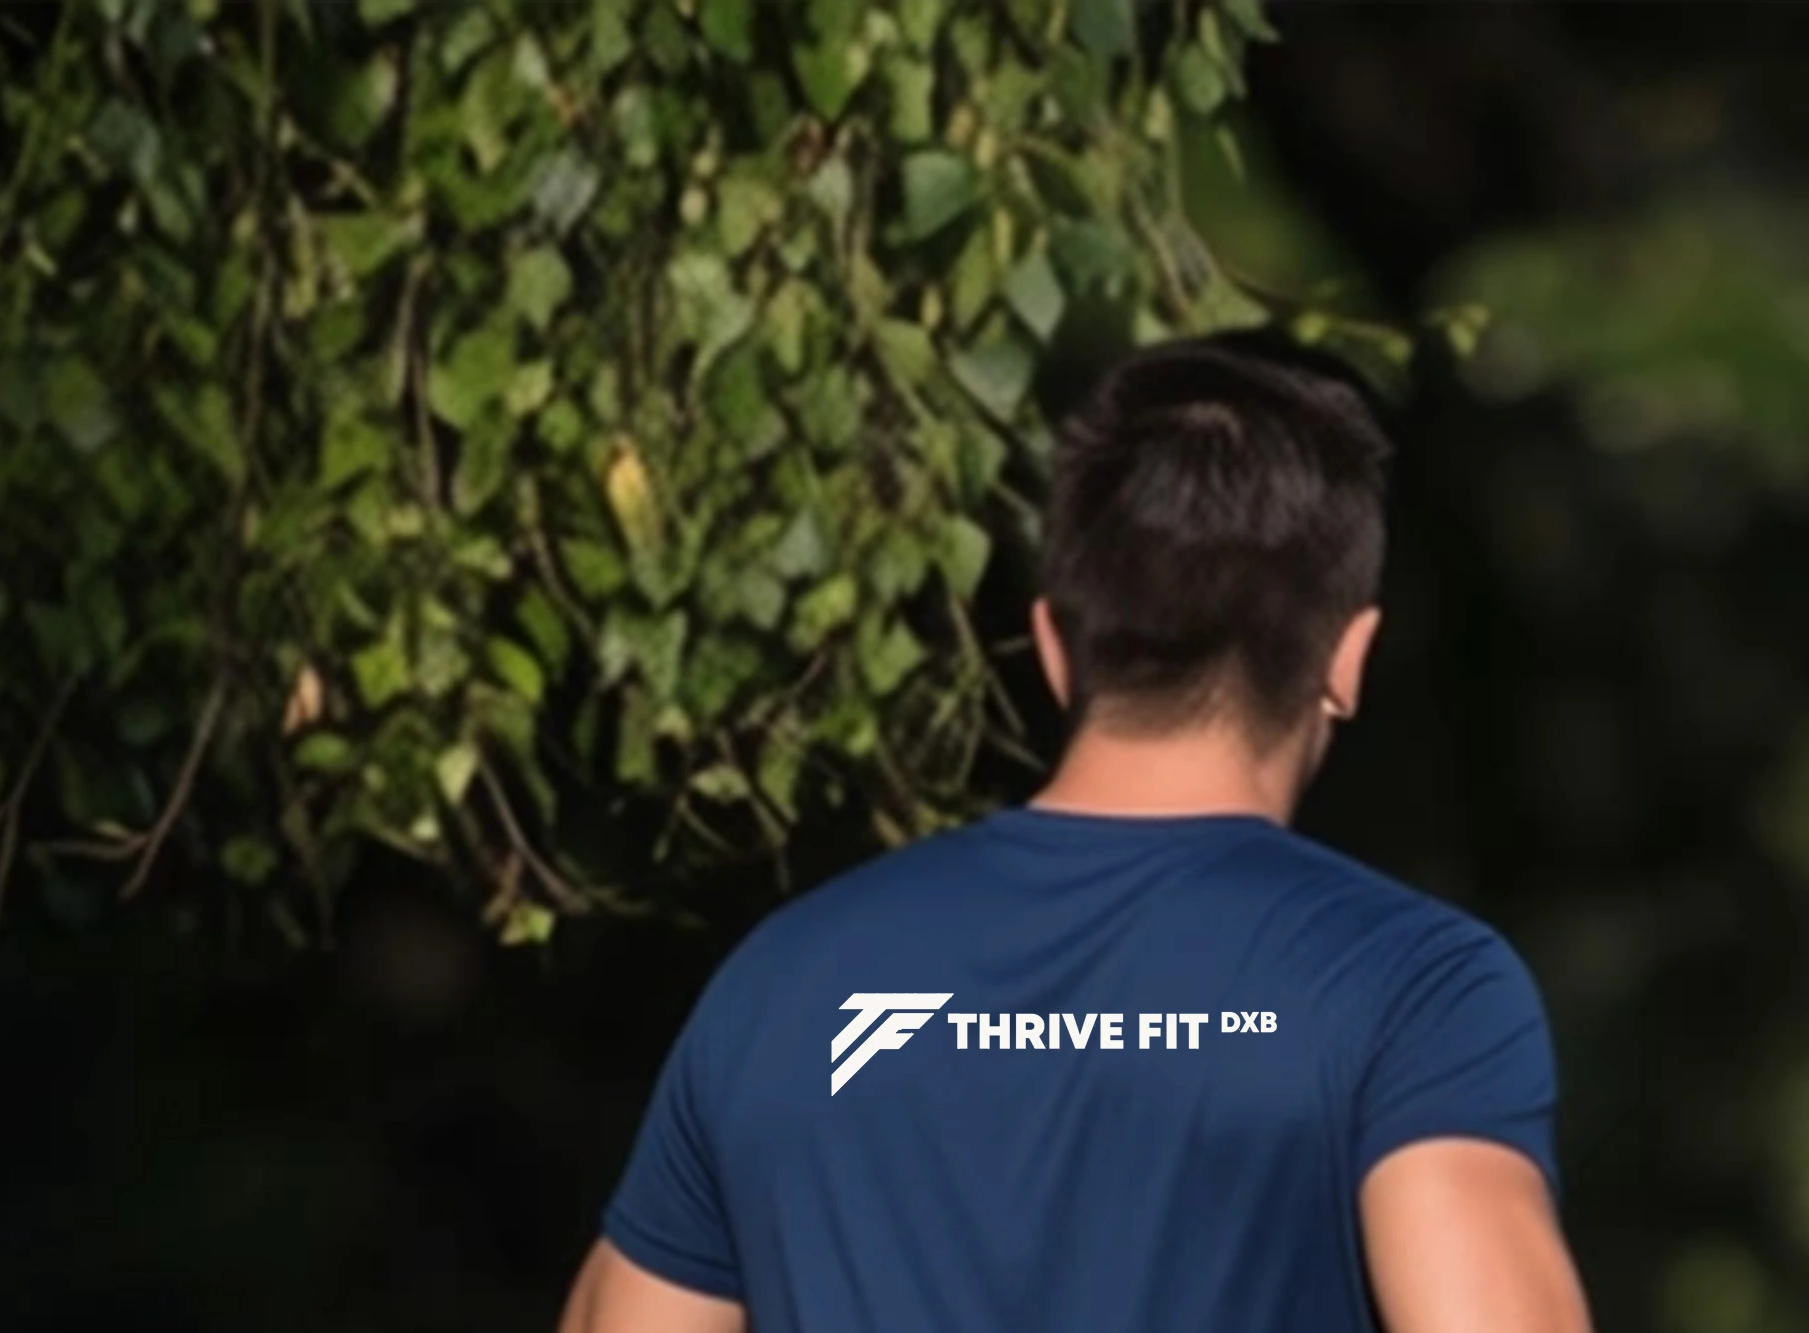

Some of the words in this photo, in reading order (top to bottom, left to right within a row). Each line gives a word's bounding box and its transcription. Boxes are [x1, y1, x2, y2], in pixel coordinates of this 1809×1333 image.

[947, 1012, 1124, 1050] THRIVE
[1138, 1012, 1209, 1050] FIT
[1221, 1011, 1279, 1033] DXB
